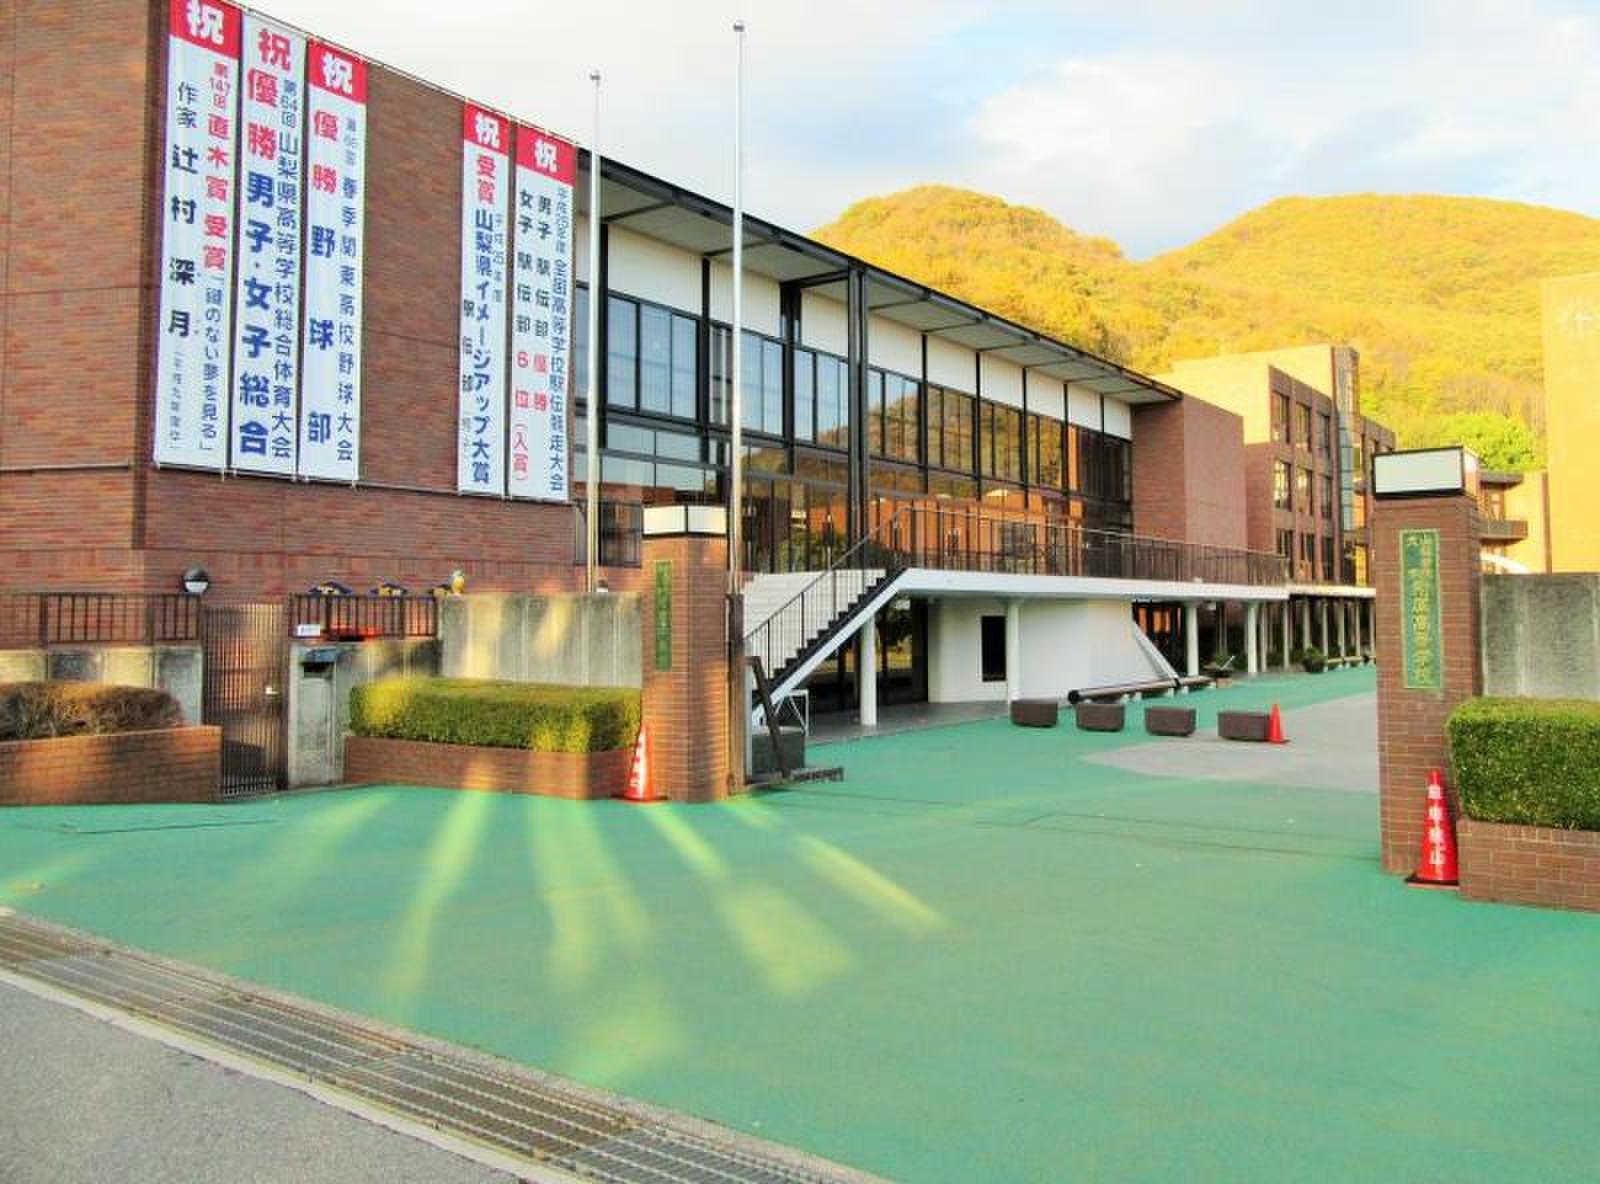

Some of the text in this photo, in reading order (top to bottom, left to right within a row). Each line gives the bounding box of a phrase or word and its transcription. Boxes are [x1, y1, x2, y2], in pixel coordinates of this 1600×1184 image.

[187, 0, 225, 44] 祝
[257, 29, 291, 71] 祝
[320, 53, 353, 94] 祝
[474, 111, 500, 149] 祝
[534, 139, 559, 173] 祝
